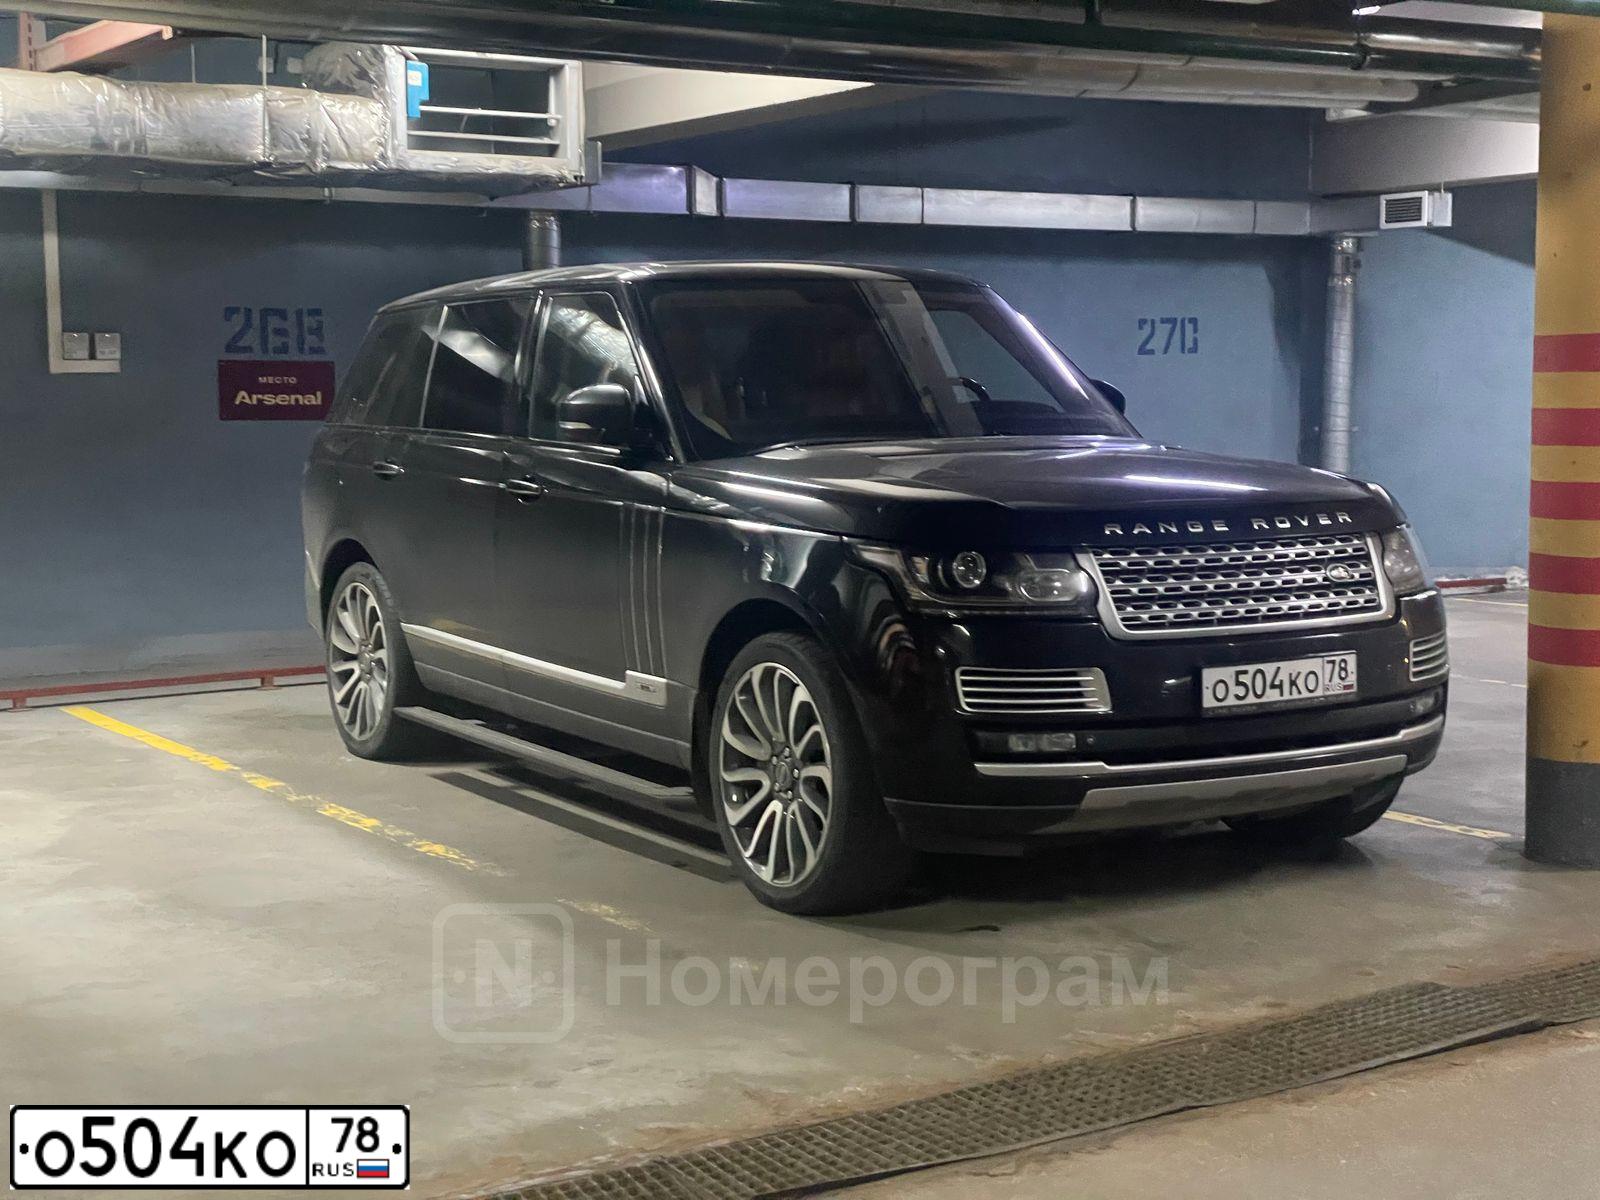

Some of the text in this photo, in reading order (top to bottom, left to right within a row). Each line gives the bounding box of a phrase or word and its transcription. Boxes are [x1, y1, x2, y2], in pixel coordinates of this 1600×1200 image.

[1137, 317, 1198, 355] 270
[258, 376, 297, 384] МЕСТО
[235, 390, 322, 405] Arsenal
[1104, 511, 1352, 535] RANGE ROVER
[1326, 658, 1349, 683] 78
[1324, 682, 1343, 692] RUS
